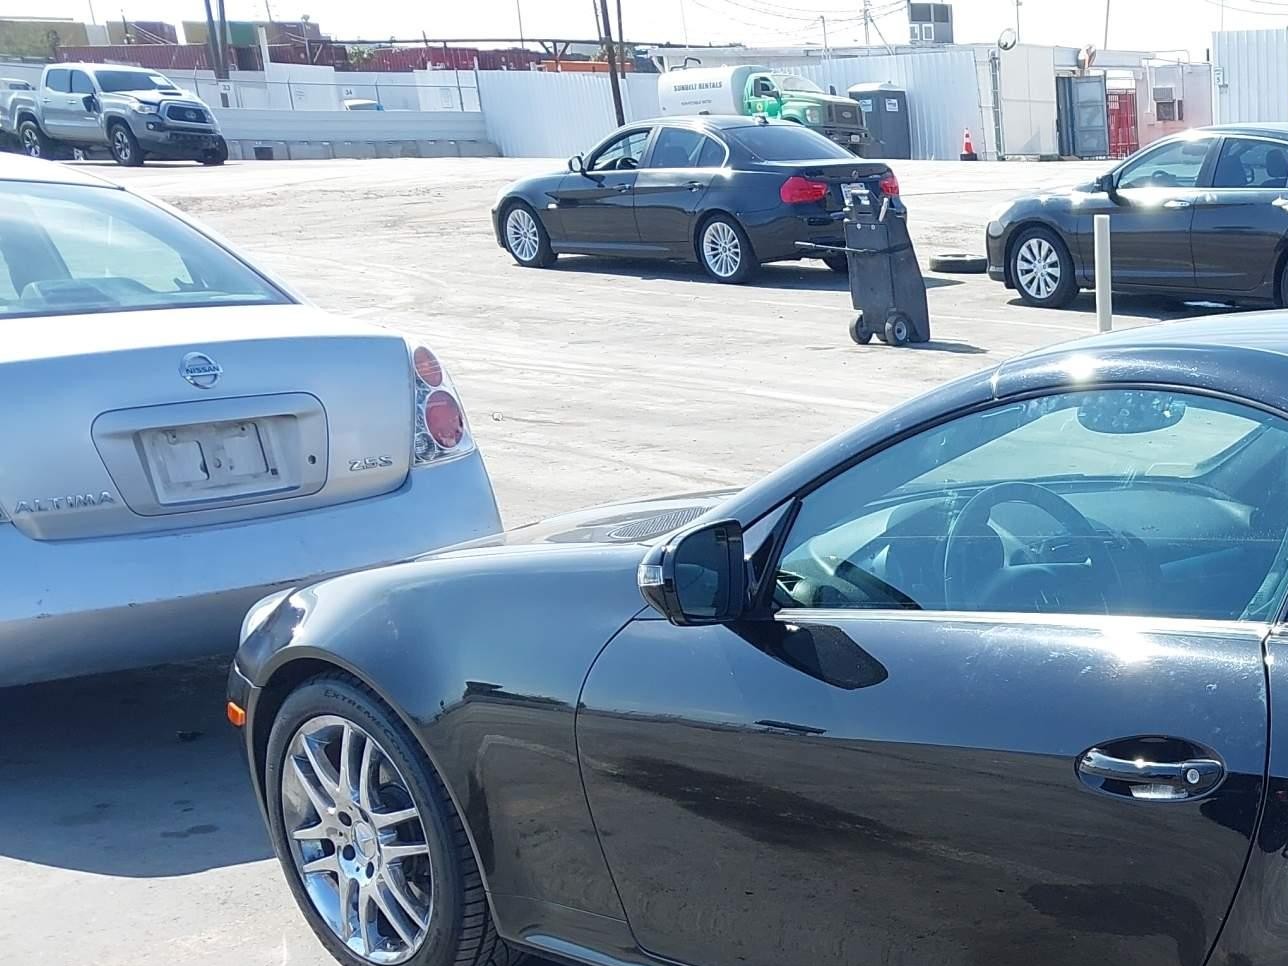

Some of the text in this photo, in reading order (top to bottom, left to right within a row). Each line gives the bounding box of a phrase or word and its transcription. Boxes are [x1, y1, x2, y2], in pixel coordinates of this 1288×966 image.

[698, 81, 722, 90] RENTALS
[184, 365, 220, 375] NISSAN
[15, 491, 115, 513] ALTIMA
